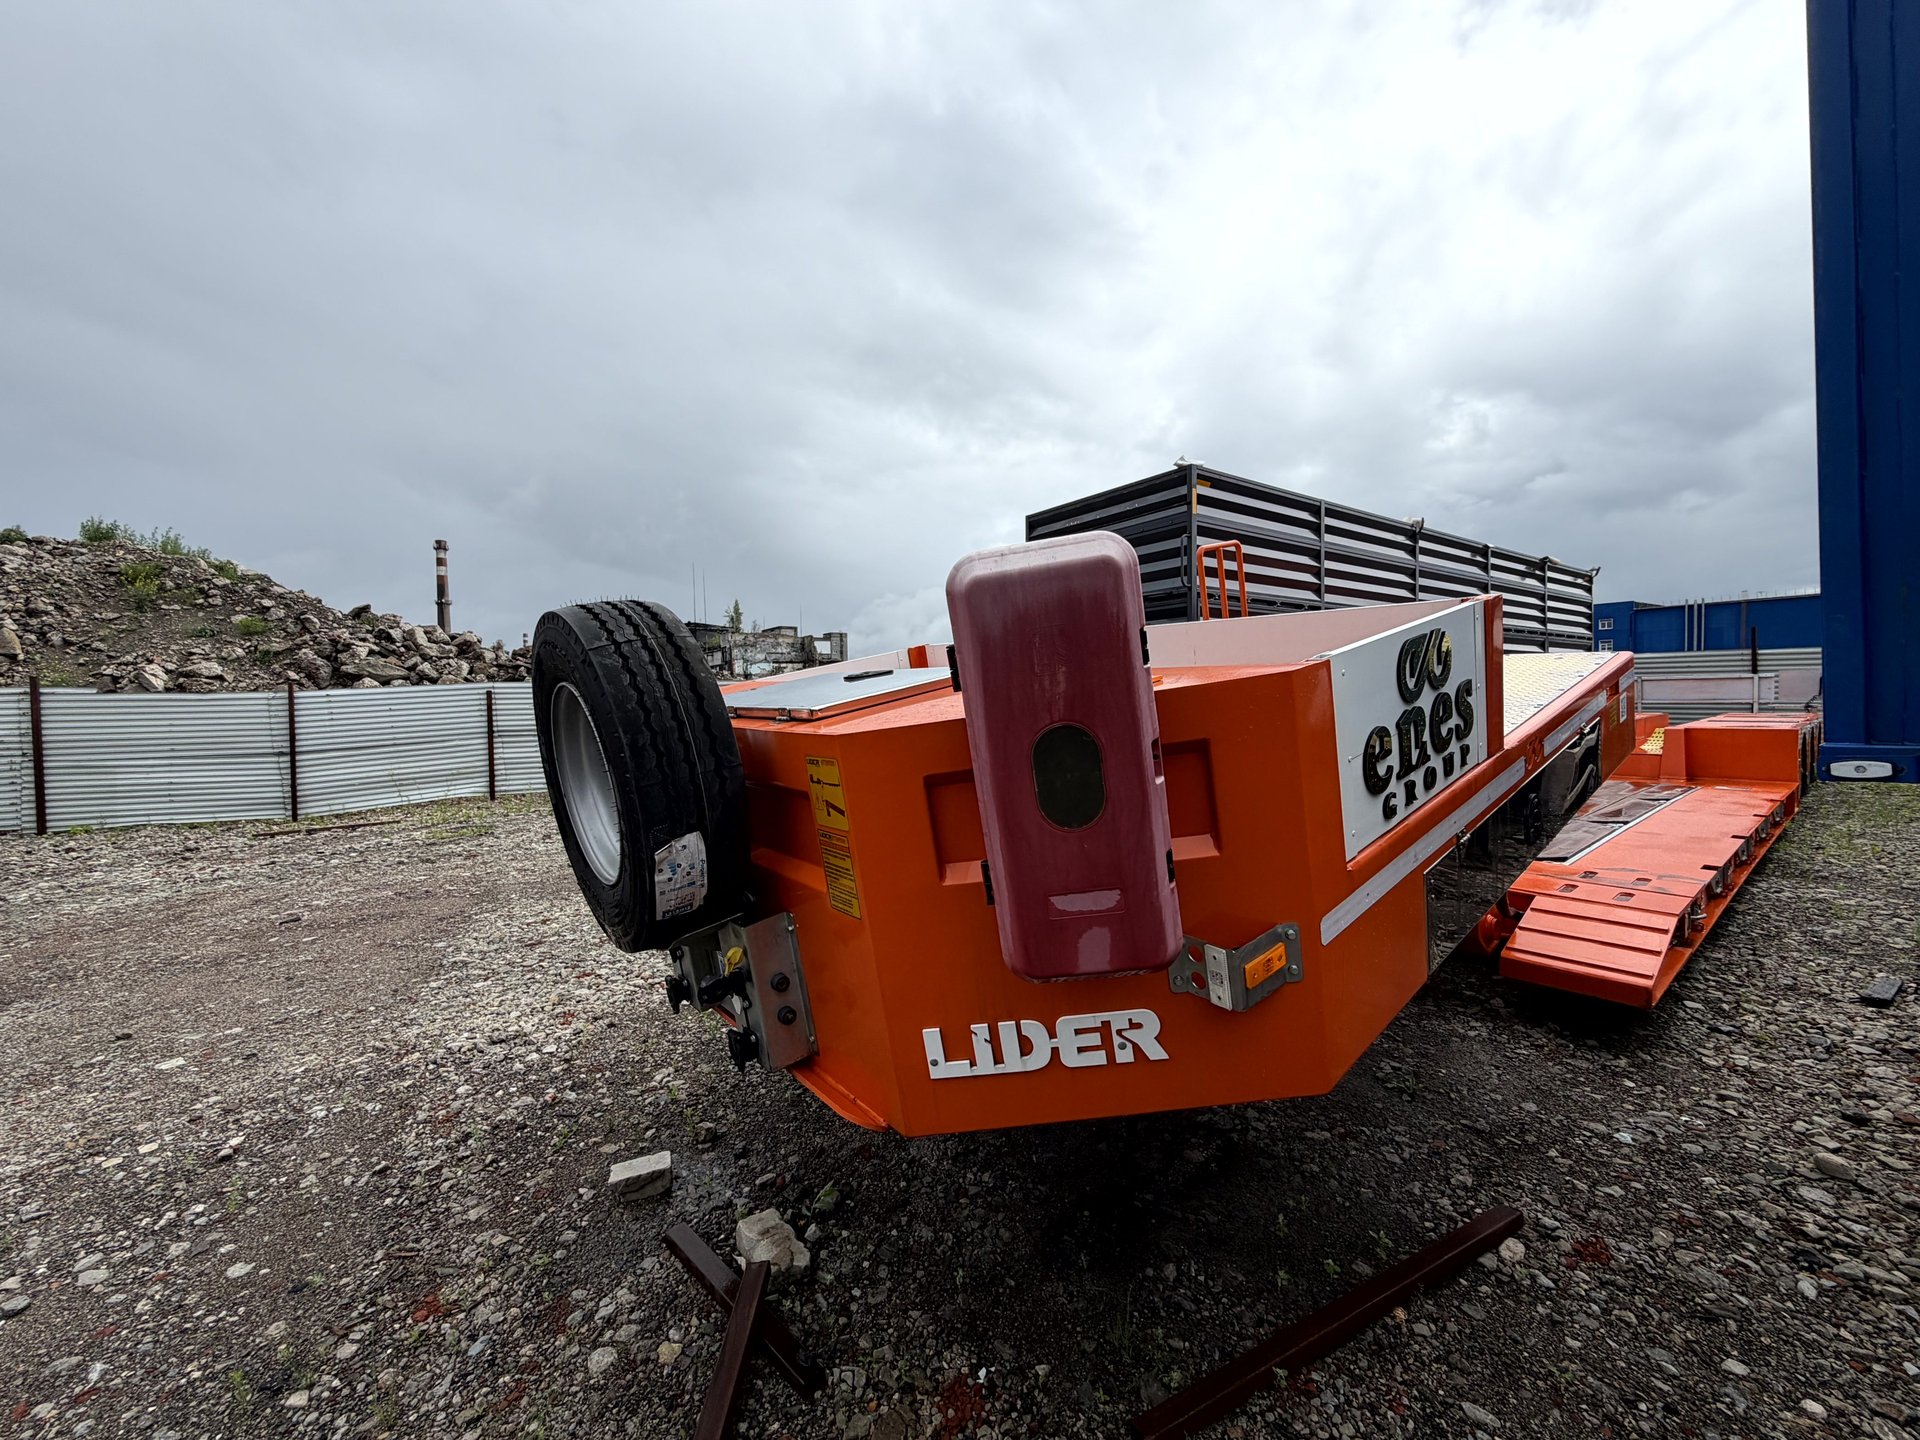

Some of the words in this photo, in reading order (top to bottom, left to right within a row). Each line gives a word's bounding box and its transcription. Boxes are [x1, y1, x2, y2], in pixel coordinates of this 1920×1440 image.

[1363, 678, 1474, 795] enes
[1383, 745, 1470, 819] GROUP
[922, 1008, 1169, 1079] LIDER
